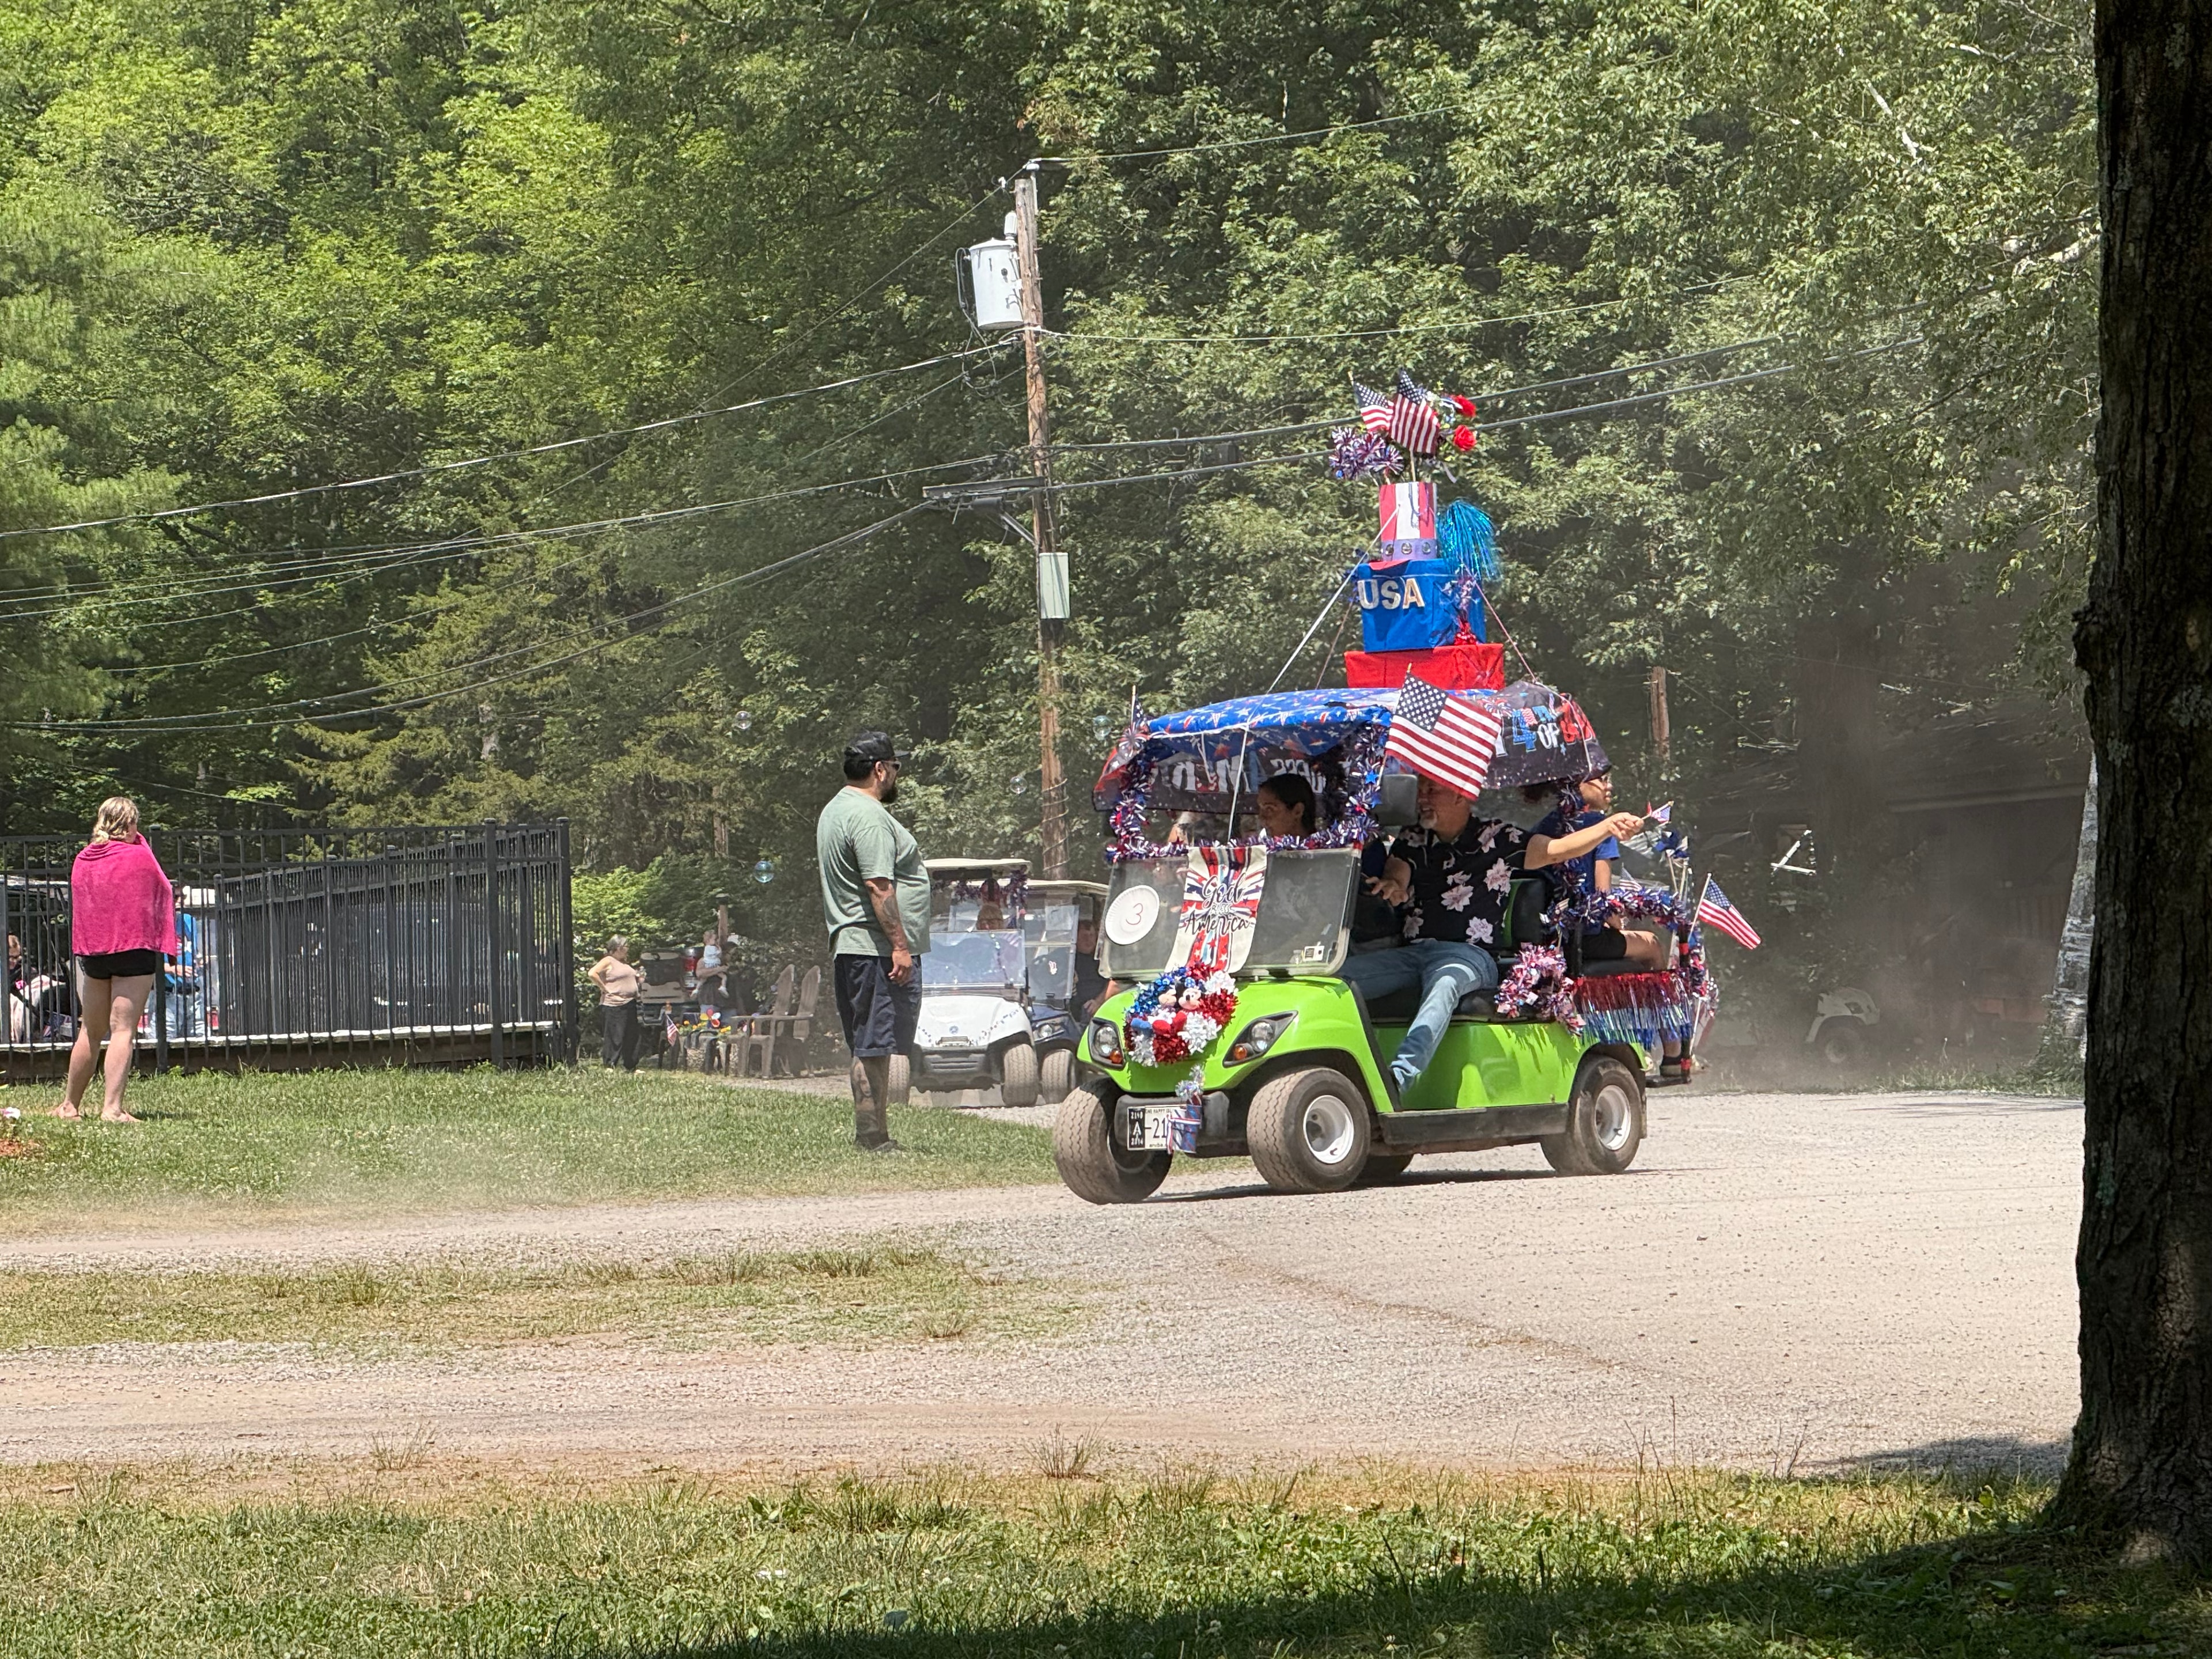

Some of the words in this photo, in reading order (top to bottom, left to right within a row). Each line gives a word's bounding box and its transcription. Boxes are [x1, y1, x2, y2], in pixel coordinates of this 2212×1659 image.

[1357, 578, 1426, 609] USA
[1202, 873, 1245, 908] God
[1126, 903, 1143, 926] 3
[1185, 910, 1251, 935] America
